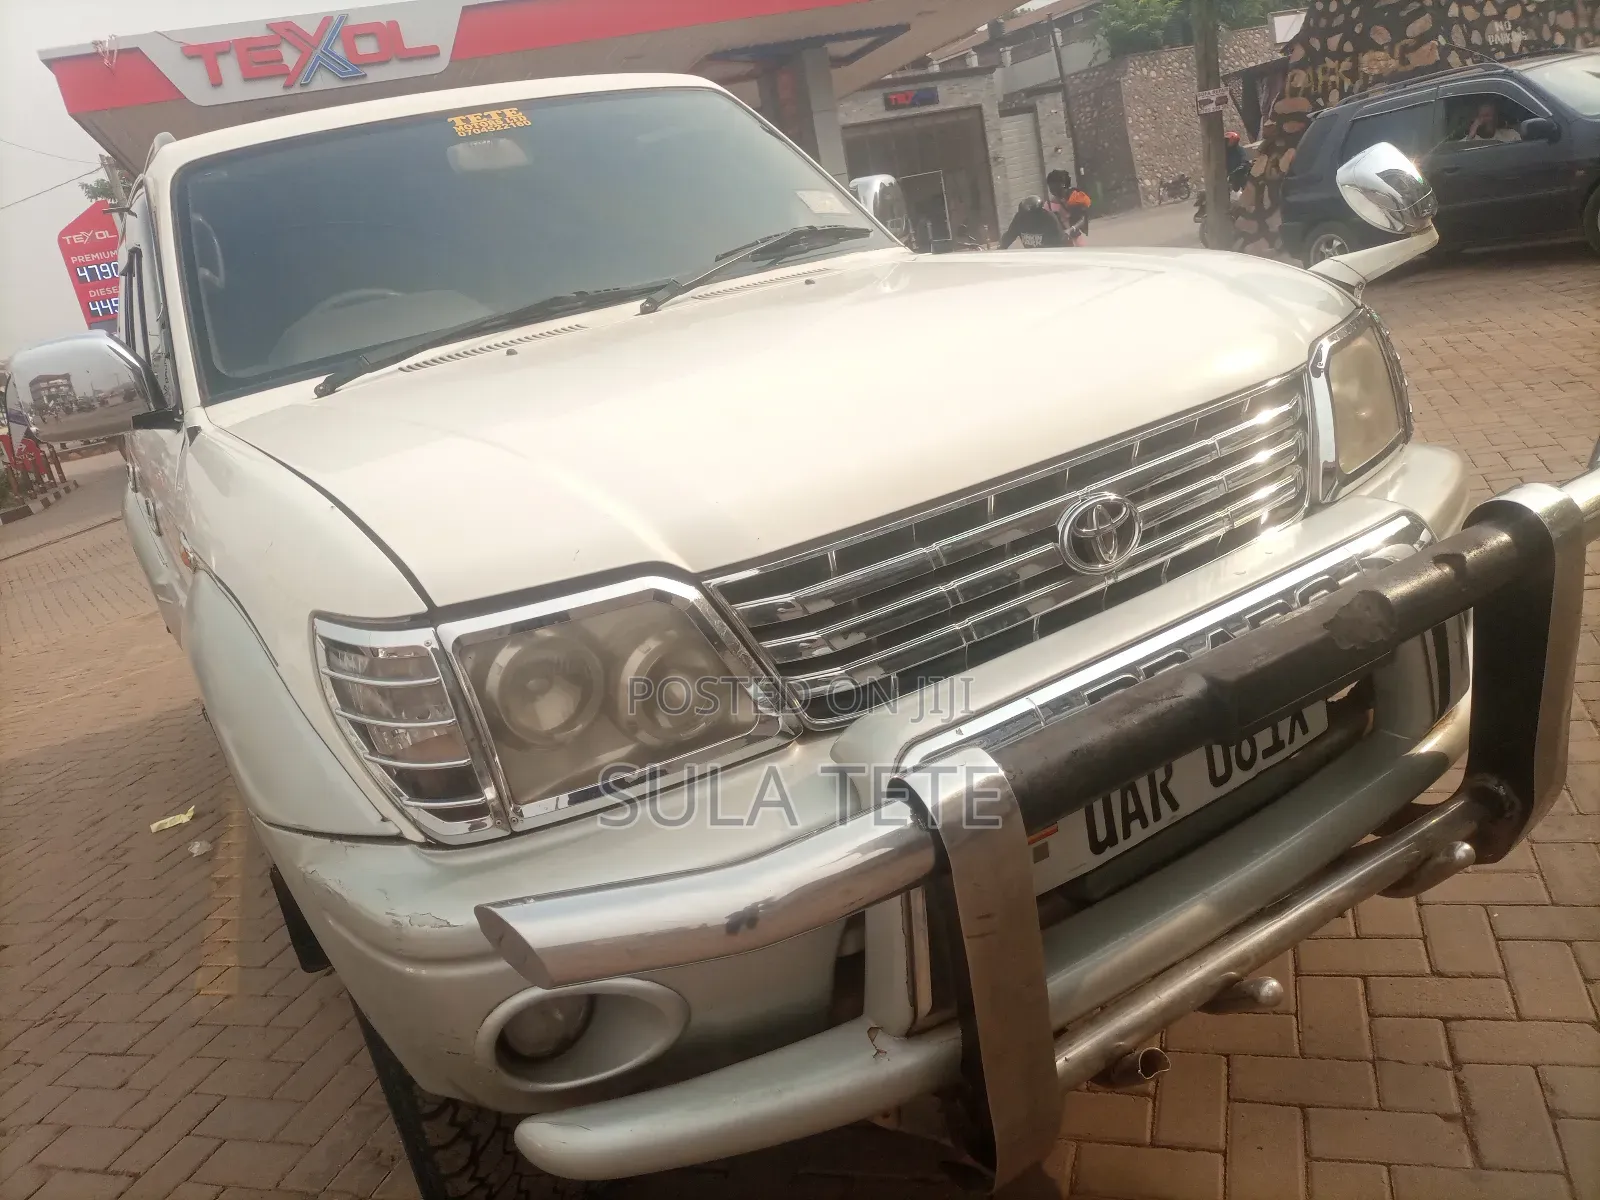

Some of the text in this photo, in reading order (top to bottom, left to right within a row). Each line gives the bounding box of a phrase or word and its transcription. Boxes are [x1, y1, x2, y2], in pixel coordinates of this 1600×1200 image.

[1494, 20, 1512, 31] NO
[180, 14, 440, 88] TEXOL
[447, 108, 522, 126] TETE
[453, 118, 504, 133] MOTORS
[70, 249, 118, 264] PREMIUM
[88, 285, 119, 298] DIESE
[88, 297, 119, 317] 445
